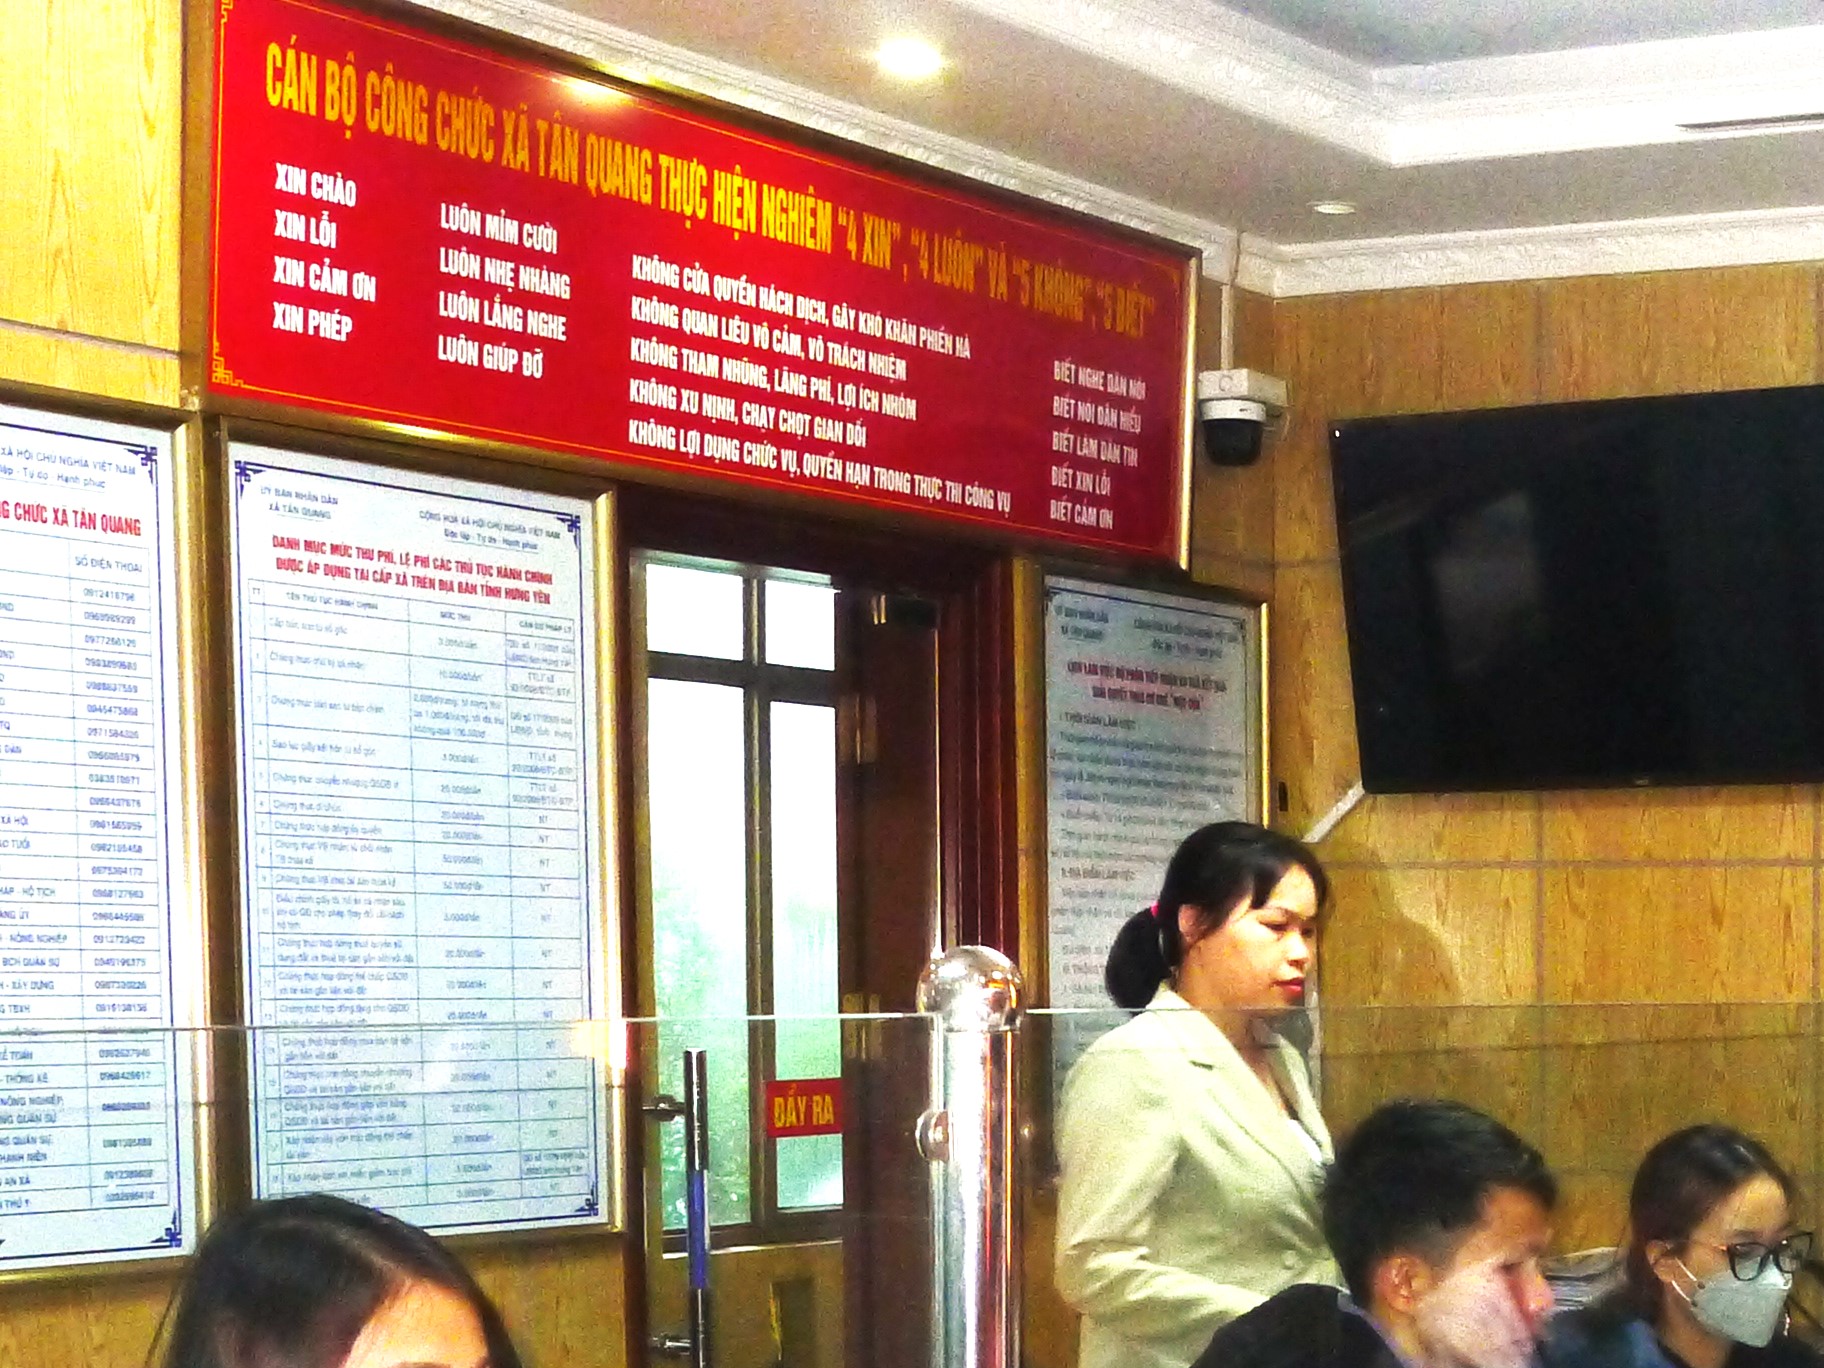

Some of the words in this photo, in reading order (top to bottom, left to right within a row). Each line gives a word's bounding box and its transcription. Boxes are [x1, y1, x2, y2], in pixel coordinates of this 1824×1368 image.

[275, 162, 307, 196] XIN
[311, 171, 357, 208] CHÀO
[274, 209, 306, 242] XIN
[310, 210, 338, 249] LỖI
[440, 202, 482, 237] LUÔN
[485, 209, 520, 245] MỈM
[522, 221, 559, 255] CƯỜI
[273, 255, 306, 288] XIN
[309, 257, 349, 297] CẢM
[352, 271, 377, 302] ƠN
[440, 246, 481, 280] LUÔN
[484, 256, 516, 293] NHẸ
[519, 264, 571, 300] NHÀNG
[273, 301, 305, 334] XIN
[307, 308, 353, 342] PHÉP
[439, 289, 481, 324] LUÔN
[483, 294, 524, 333] LẮNG
[527, 309, 567, 342] NGHE
[632, 254, 681, 289] KHÔNG
[682, 262, 711, 296] CỬA
[759, 284, 794, 317] HÁCH
[796, 295, 830, 327] DỊCH,
[832, 302, 856, 330] GÂY
[858, 310, 883, 338] KHÓ
[885, 318, 917, 346] KHĂN
[919, 326, 954, 355] PHIỀN
[438, 333, 480, 367] LUÔN
[482, 342, 520, 373] GIÚP
[522, 348, 544, 379] ĐỠ
[631, 295, 680, 329] KHÔNG
[681, 307, 719, 338] QUAN
[721, 315, 751, 345] LIÊU
[752, 322, 770, 350] VÔ
[772, 324, 806, 361] CẢM,
[807, 334, 825, 362] VÔ
[826, 341, 866, 372] TRÁCH
[868, 351, 907, 383] NHIỆM
[630, 336, 679, 370] KHÔNG
[681, 347, 720, 378] THAM
[722, 357, 772, 385] NHŨNG,
[773, 366, 808, 397] LÃNG
[810, 375, 836, 406] PHÍ,
[837, 382, 858, 410] LỢI
[859, 383, 880, 413] ÍCH
[881, 392, 917, 421] NHÓM
[629, 377, 678, 411] KHÔNG
[680, 388, 700, 415] XU
[701, 393, 739, 425] NỊNH,
[741, 401, 777, 433] CHẠY
[778, 408, 812, 440] CHỌT
[813, 416, 844, 444] GIAN
[845, 420, 868, 448] DỐI
[629, 418, 677, 451] KHÔNG
[679, 429, 701, 458] LỢI
[703, 433, 741, 463] DỤNG
[743, 440, 779, 470] CHỨC
[780, 448, 801, 477] VỤ,
[802, 452, 842, 481] QUYỀN
[844, 461, 872, 489] HẠN
[873, 466, 912, 494] TRONG
[913, 474, 943, 502] THỰC
[945, 480, 963, 504] THI
[965, 481, 995, 510] CÔNG
[812, 1093, 834, 1126] RA
